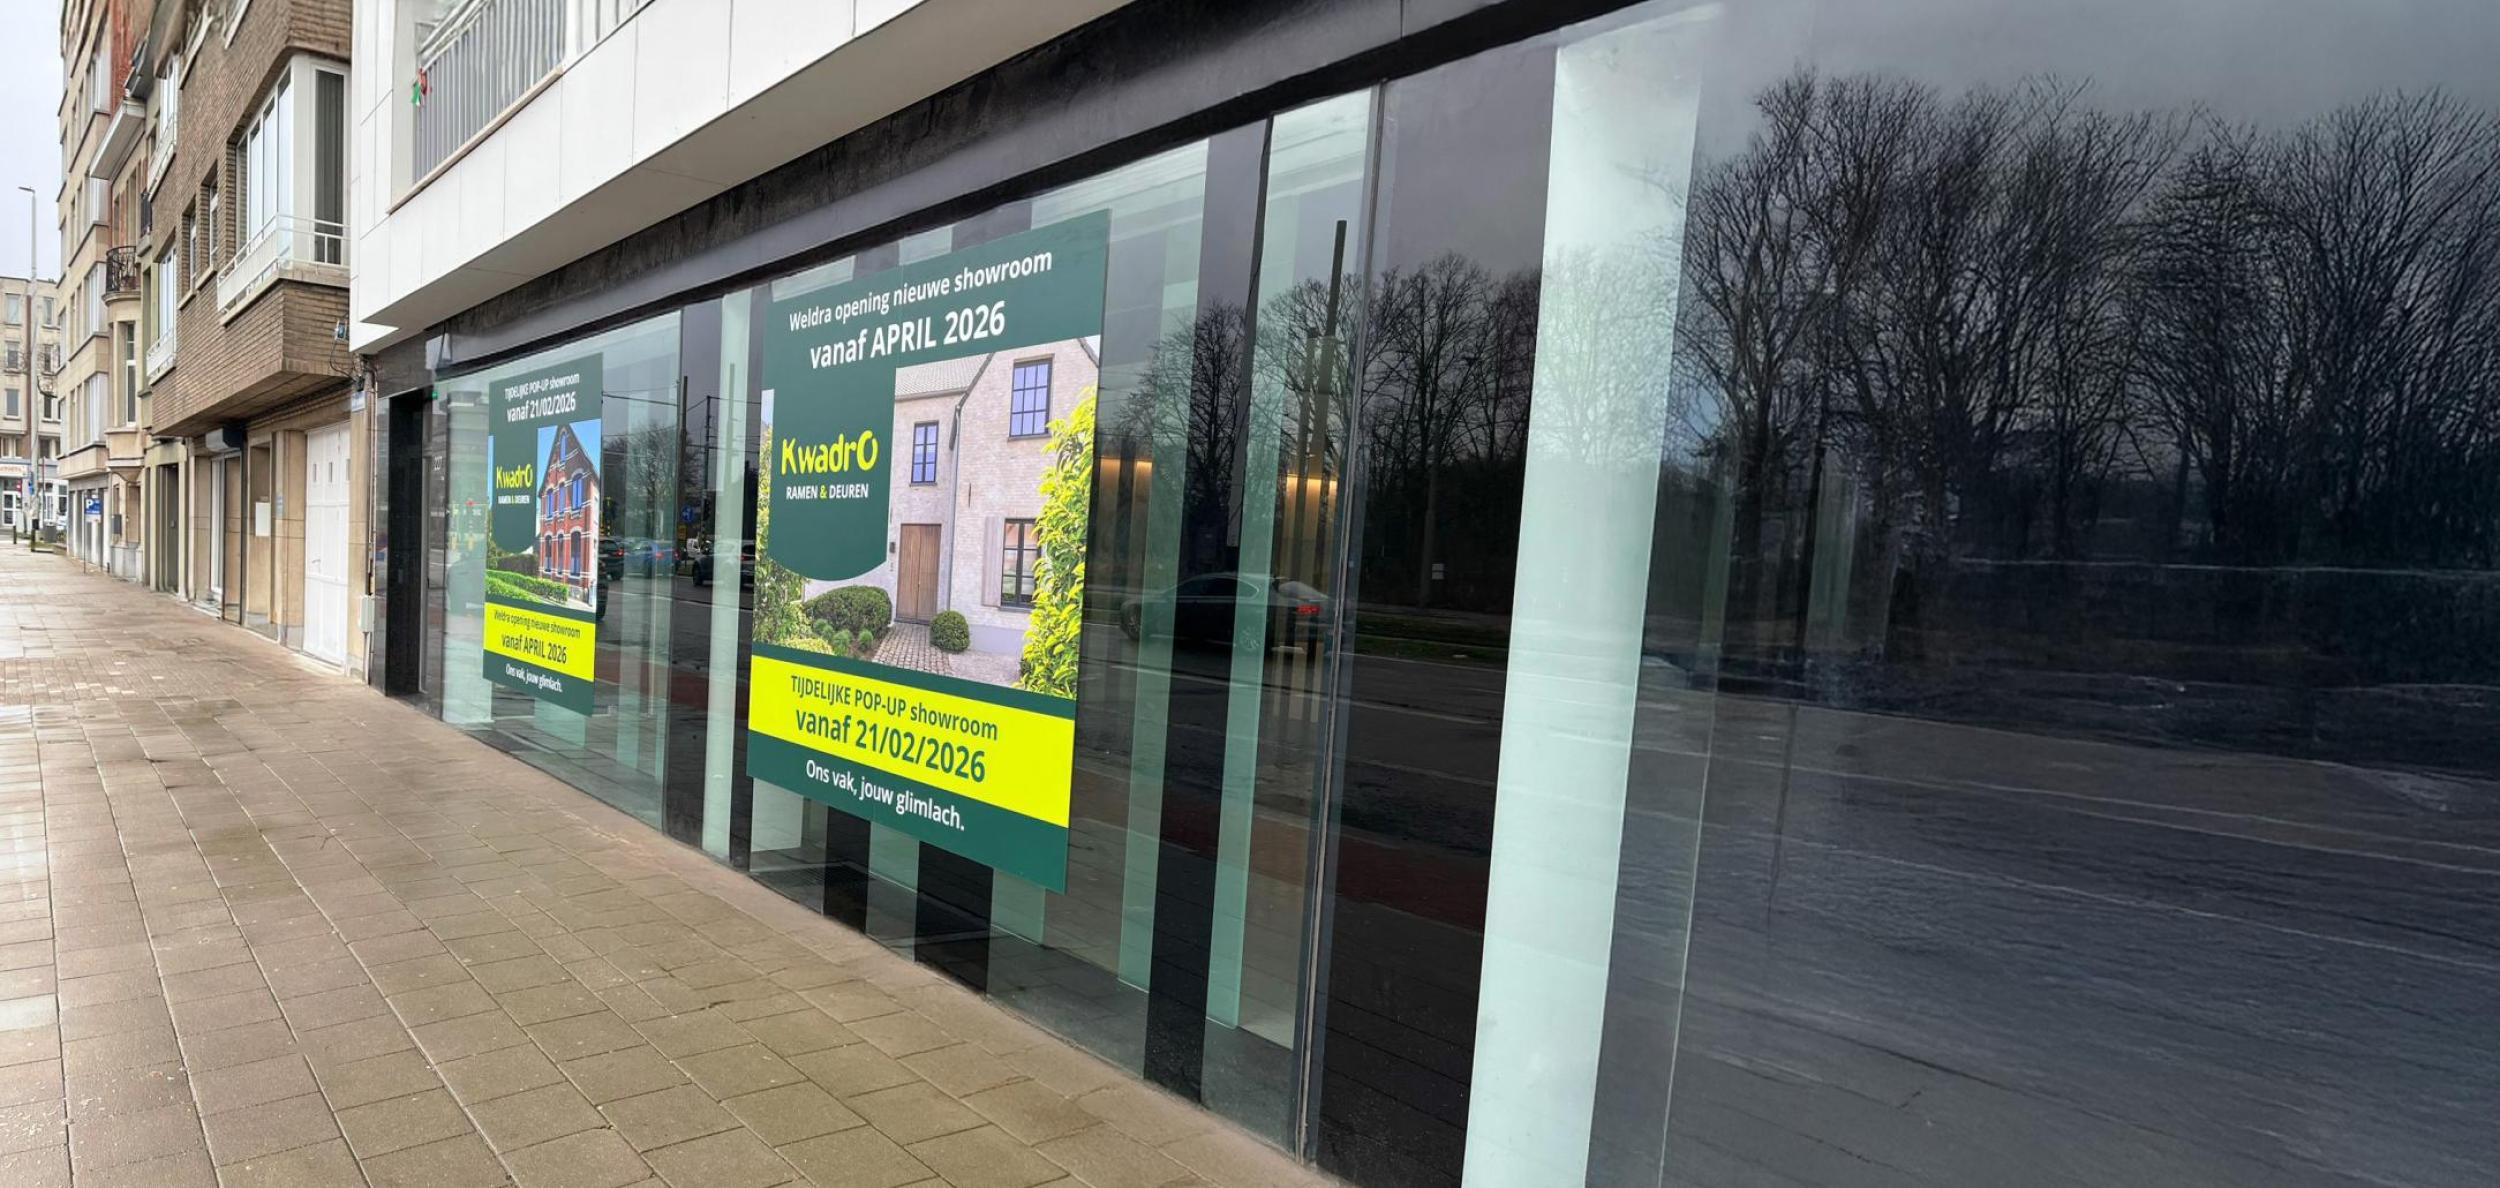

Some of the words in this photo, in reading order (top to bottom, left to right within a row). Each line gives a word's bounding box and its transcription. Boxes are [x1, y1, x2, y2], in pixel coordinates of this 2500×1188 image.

[789, 304, 832, 332] Weldra
[835, 292, 890, 325] opening
[893, 277, 950, 306] nieuwe
[953, 250, 1053, 293] showroom
[810, 331, 868, 369] vanaf
[870, 314, 937, 358] APRIL
[943, 300, 1006, 345] 2026
[529, 379, 549, 394] POP-UP
[550, 374, 580, 390] showroom
[507, 400, 529, 422] vanaf
[530, 391, 576, 418] 21/02/2026
[786, 485, 818, 500] RAMEN
[819, 484, 828, 499] &
[828, 483, 869, 499] DEUREN
[511, 614, 530, 631] opening
[530, 620, 550, 632] nieuwe
[550, 622, 580, 639] showroom
[502, 634, 522, 650] vanaf
[524, 636, 546, 658] APRIL
[547, 642, 567, 664] 2026
[506, 663, 515, 676] Ons
[525, 669, 538, 684] jouw
[790, 675, 851, 706] TIJDELIJKE
[854, 688, 906, 718] POP-UP
[910, 702, 998, 741] showroom
[796, 708, 852, 744] vanaf
[855, 718, 986, 784] 21/02/2026
[806, 759, 830, 784] Ons
[832, 768, 858, 796] vak,
[858, 778, 893, 806] jouw
[896, 789, 966, 832] glimlach.
